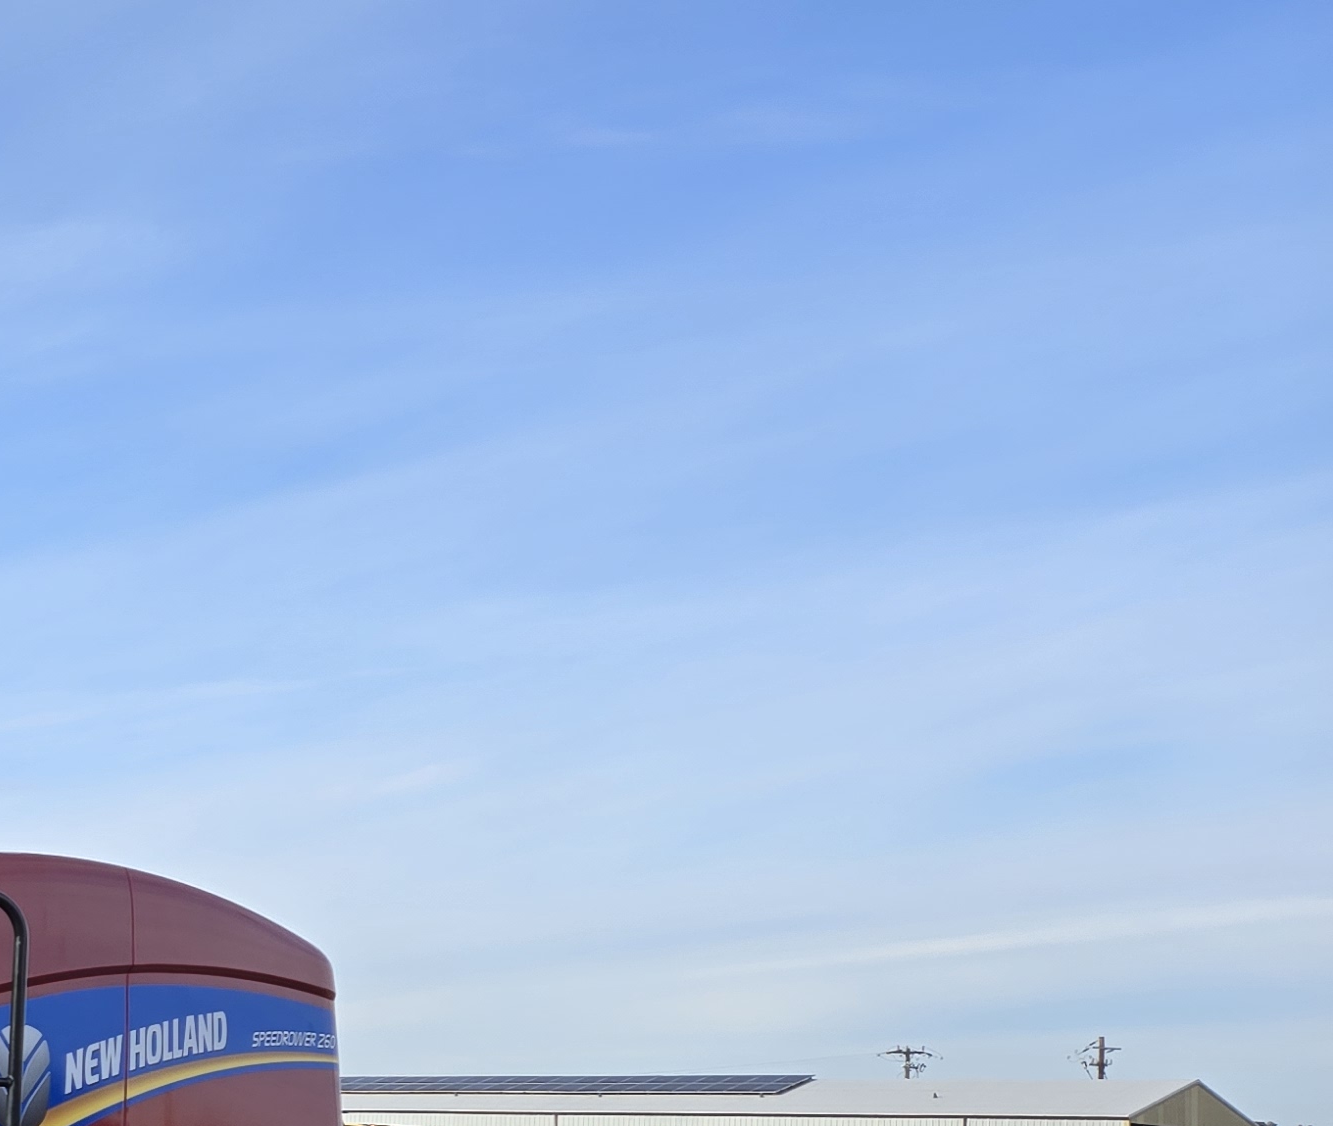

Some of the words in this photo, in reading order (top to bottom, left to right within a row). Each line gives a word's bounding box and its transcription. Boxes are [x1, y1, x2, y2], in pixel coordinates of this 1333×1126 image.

[64, 1034, 123, 1095] NEW
[129, 1011, 227, 1071] HOLLAND
[251, 1030, 317, 1048] SPEEDROWER
[317, 1033, 337, 1049] 260
